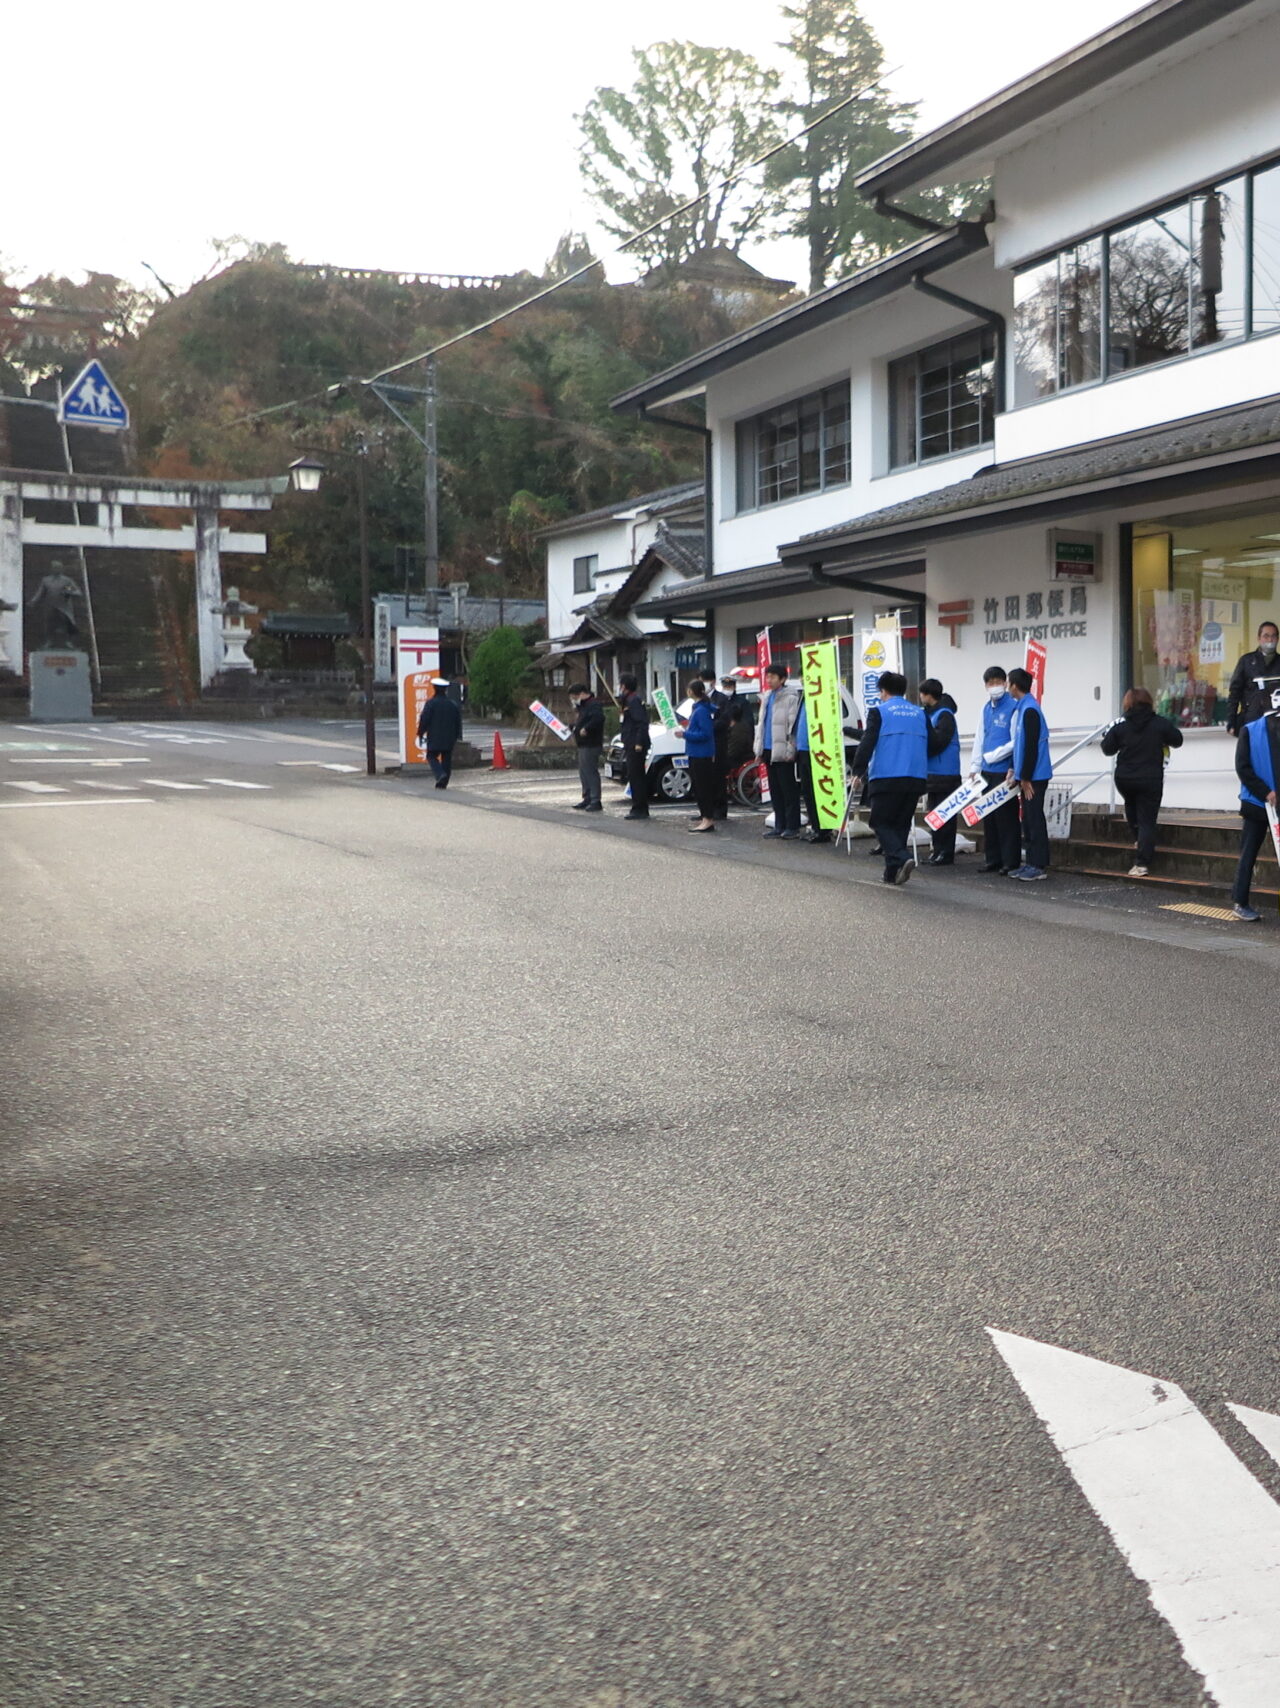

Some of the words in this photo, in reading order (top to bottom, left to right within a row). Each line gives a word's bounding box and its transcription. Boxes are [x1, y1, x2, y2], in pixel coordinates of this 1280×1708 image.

[984, 586, 1088, 625] 竹田郵便局
[984, 627, 1020, 645] TAKETA
[1051, 621, 1087, 638] OFFICE
[939, 787, 973, 819] シートベルト
[976, 787, 1009, 817] シートベルト
